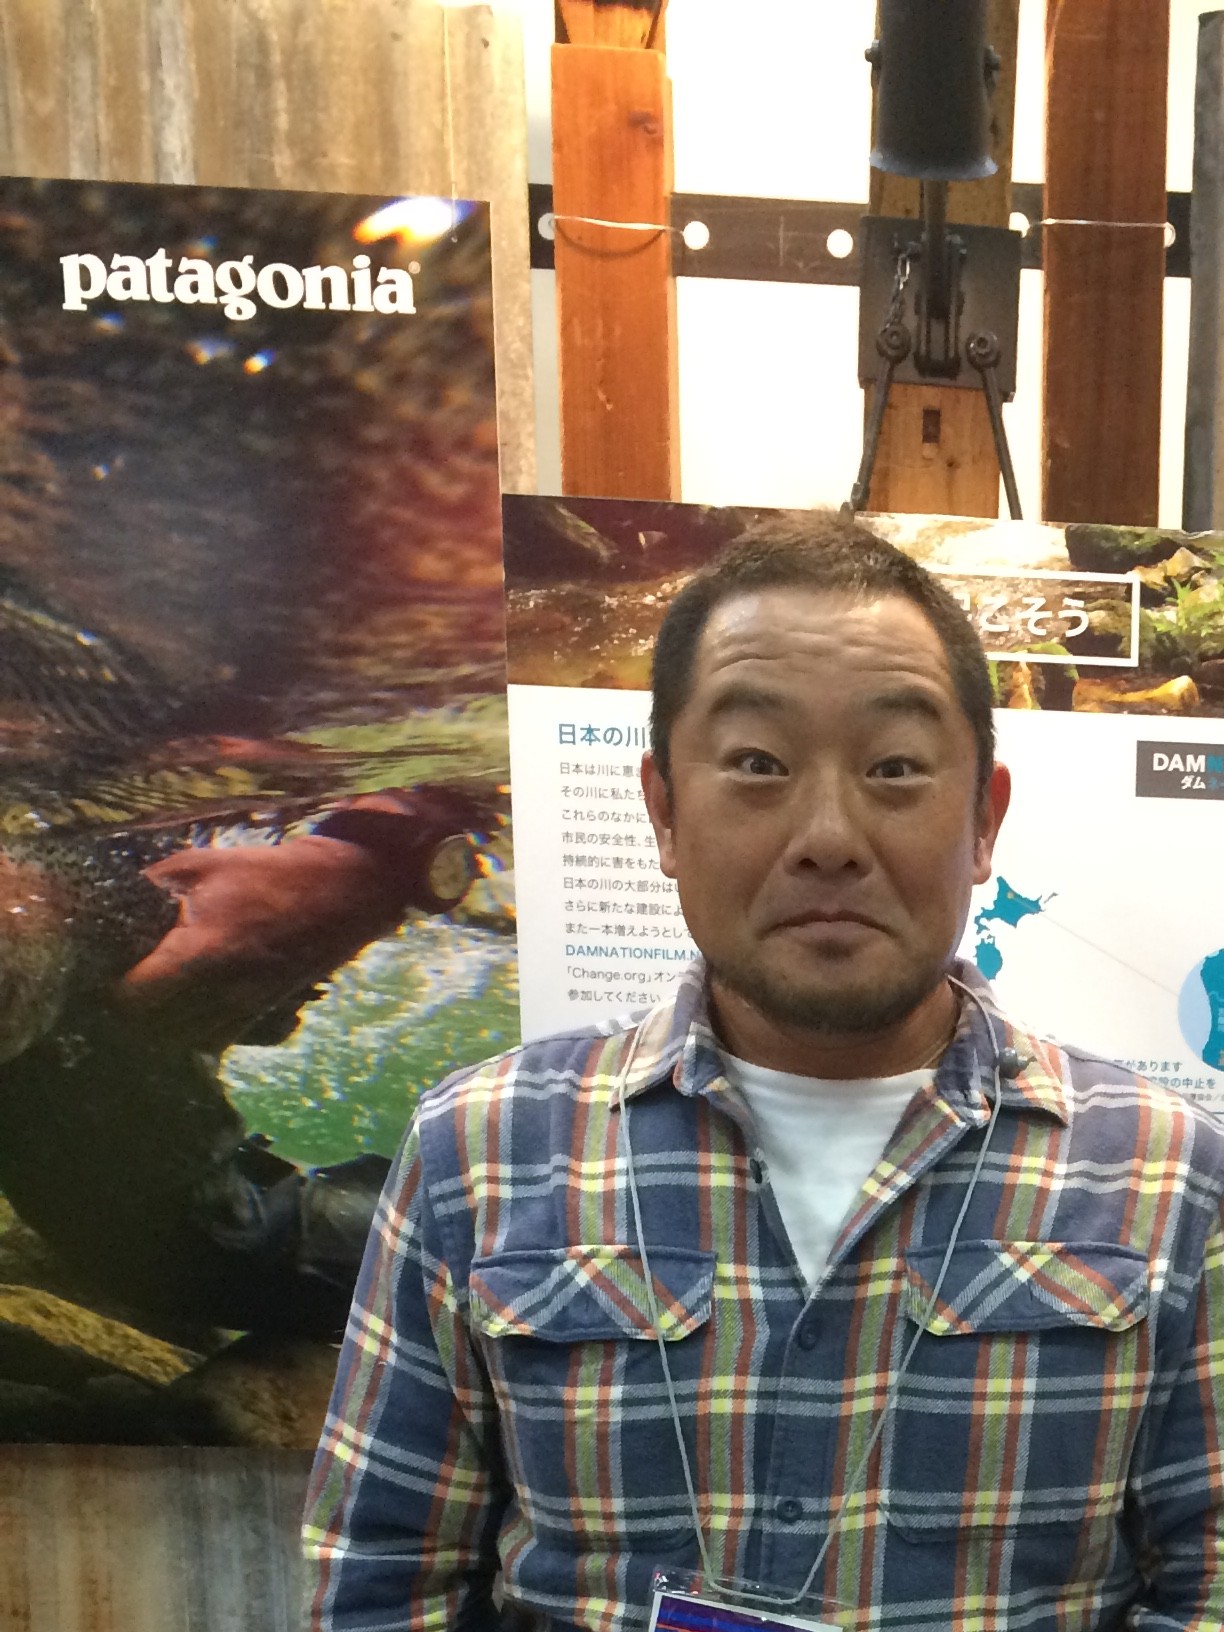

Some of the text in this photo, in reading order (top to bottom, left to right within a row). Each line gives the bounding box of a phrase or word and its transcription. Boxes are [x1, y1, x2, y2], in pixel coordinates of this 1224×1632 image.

[60, 247, 417, 320] patagonia
[957, 592, 1089, 637] こそう
[558, 723, 646, 748] 日本の川
[561, 809, 652, 823] これらのなかに
